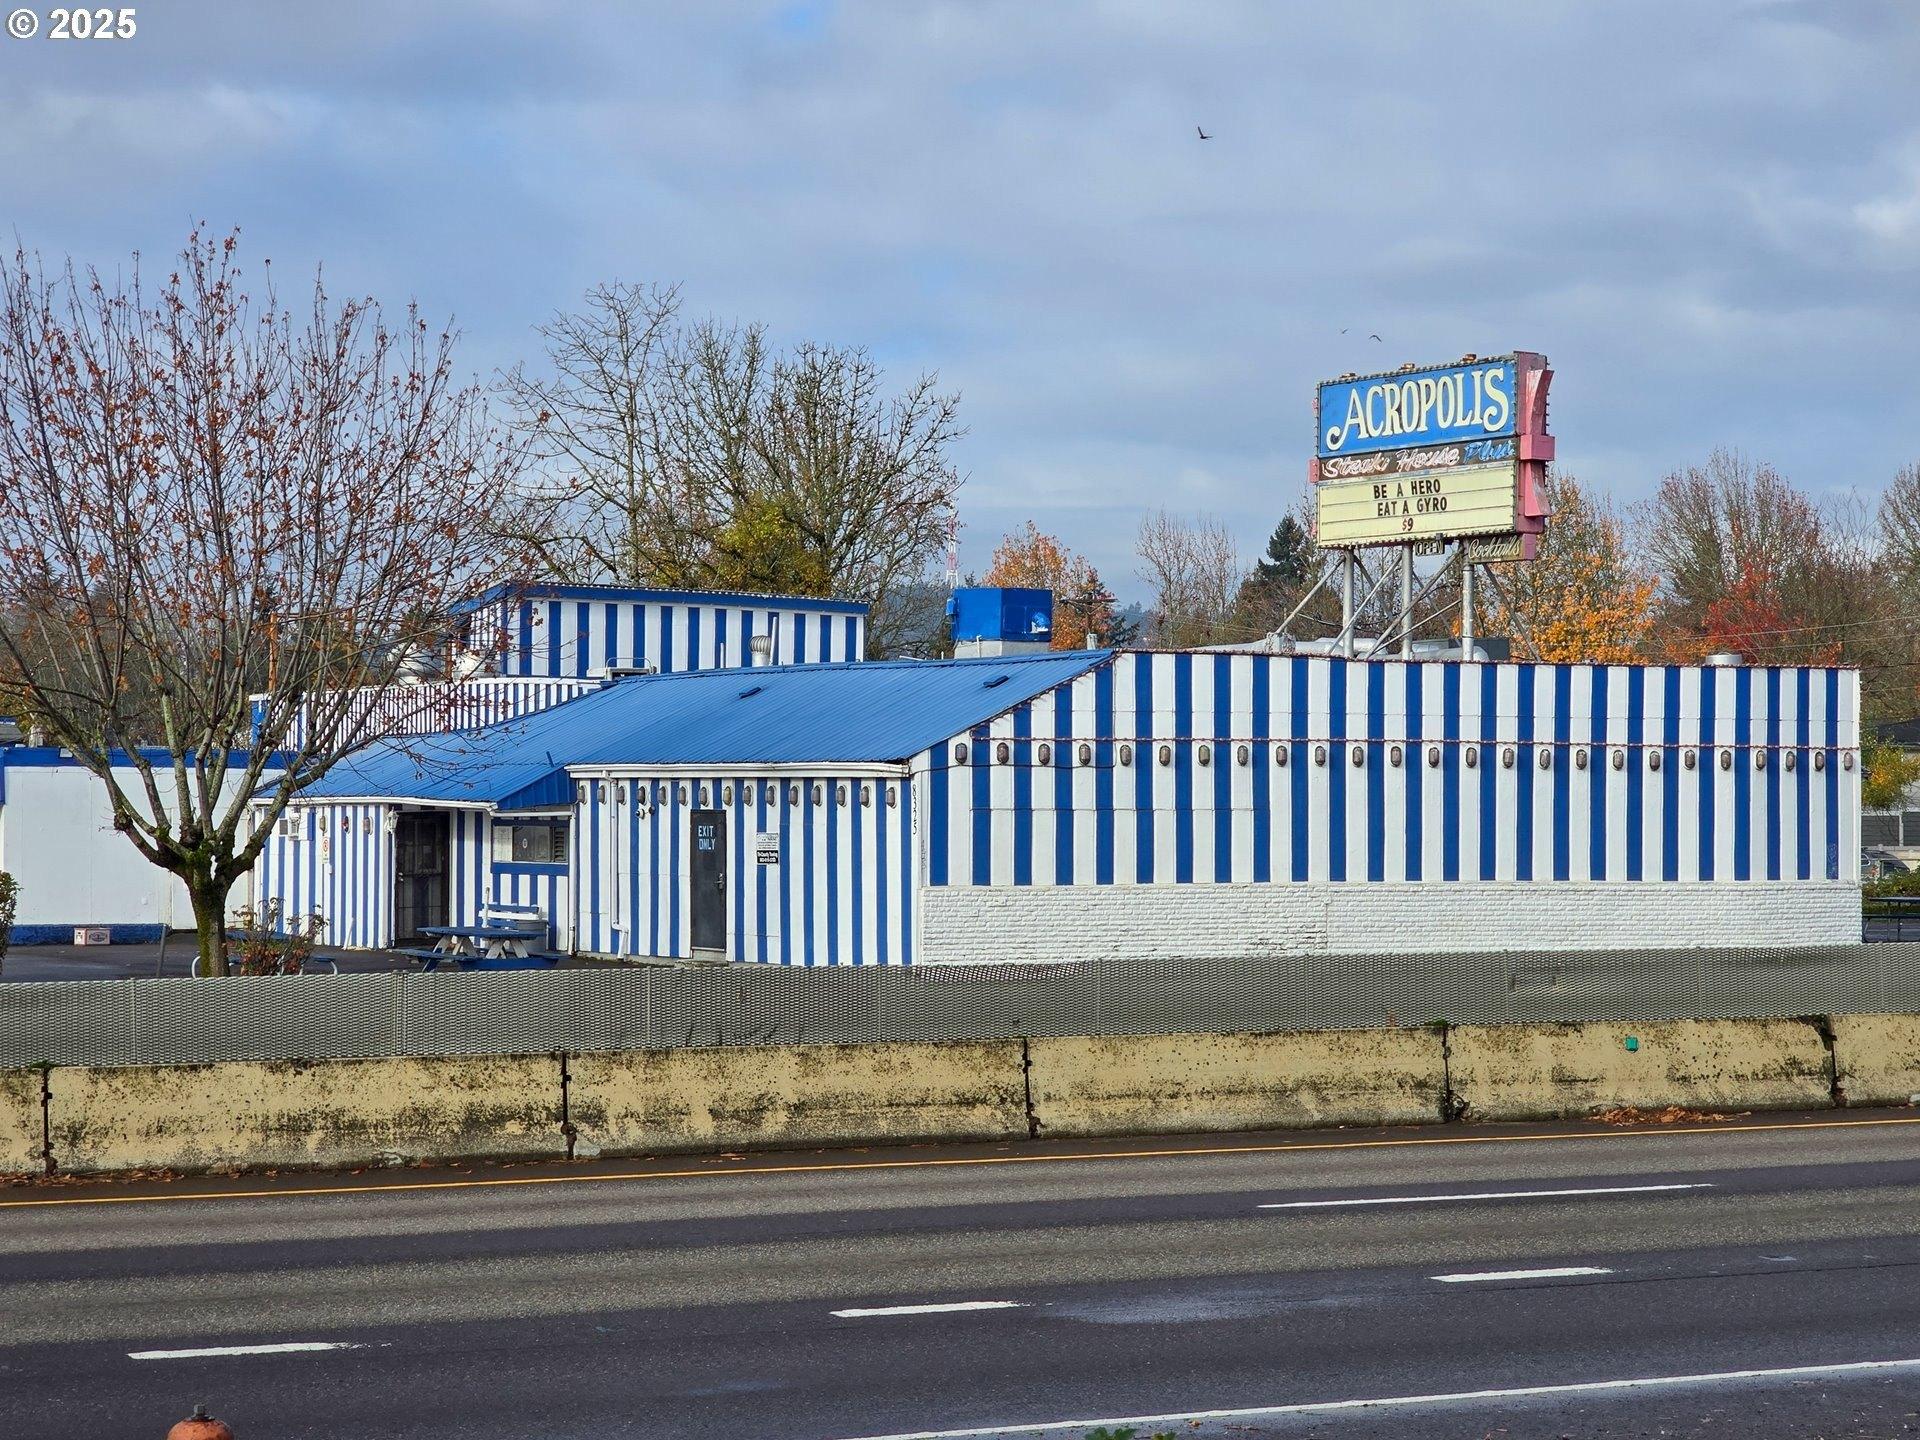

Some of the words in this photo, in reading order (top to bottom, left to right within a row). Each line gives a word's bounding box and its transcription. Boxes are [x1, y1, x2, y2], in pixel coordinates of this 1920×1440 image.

[1327, 367, 1510, 451] ACROPOLIS
[1322, 453, 1390, 478] Steak
[1396, 447, 1460, 473] House
[1373, 484, 1388, 499] BE
[1397, 483, 1404, 497] A
[1411, 479, 1441, 495] HERO
[1377, 501, 1397, 516] EAT
[1402, 500, 1410, 515] A
[1416, 497, 1448, 513] GYRO
[1402, 517, 1414, 531] $9
[1415, 541, 1444, 555] OPEN
[1468, 535, 1521, 560] Cocktails
[698, 825, 714, 837] EXIT
[698, 838, 716, 850] ONLY
